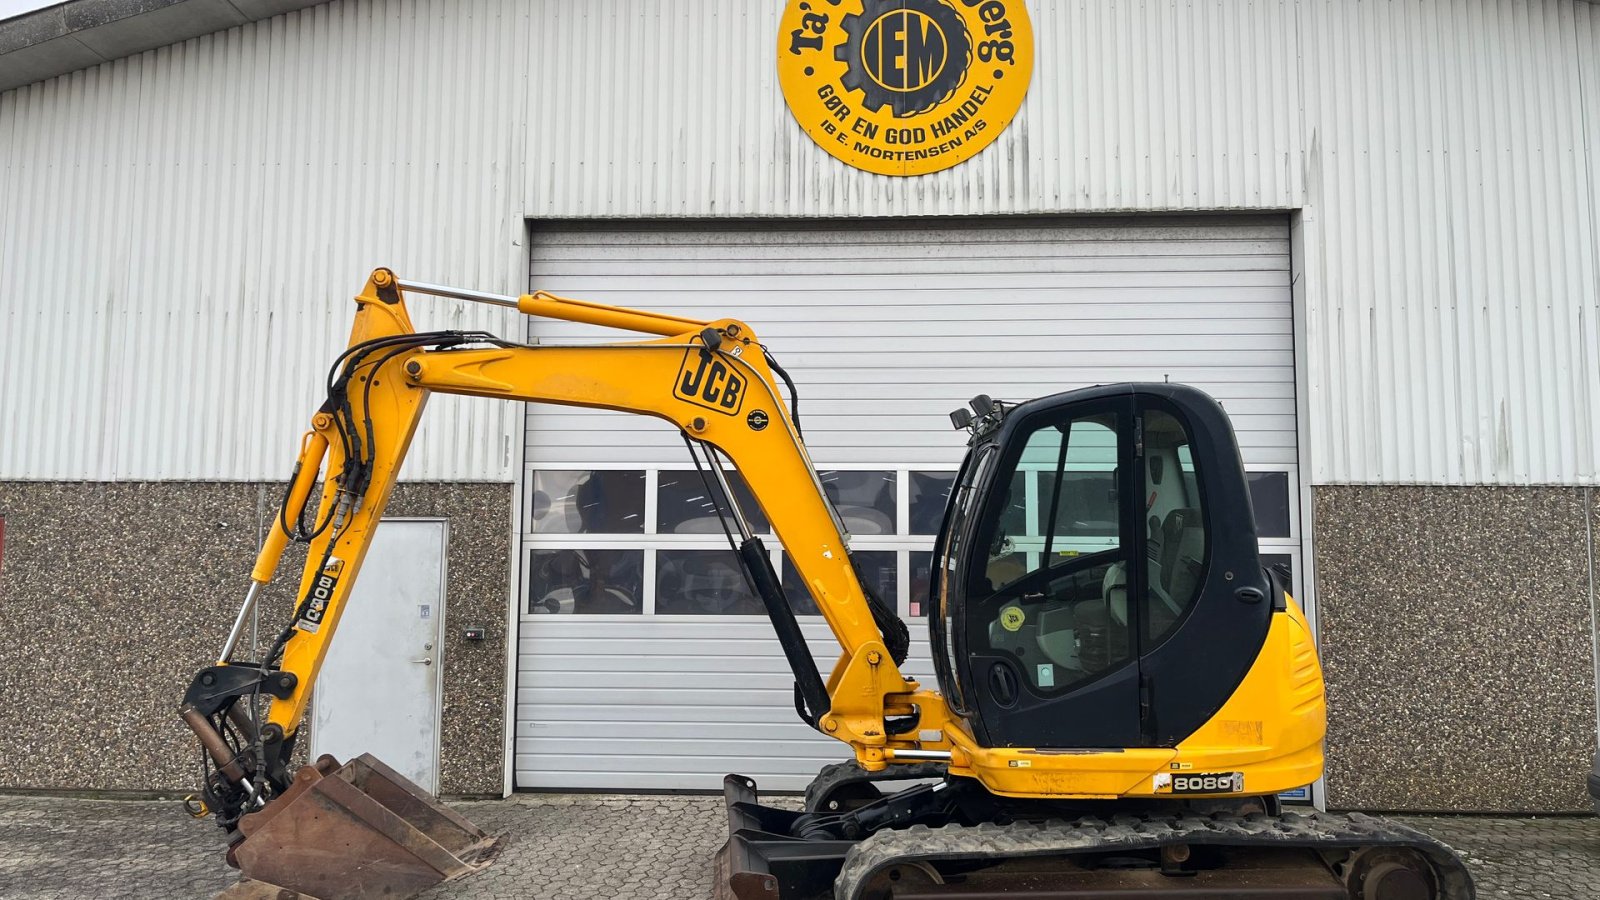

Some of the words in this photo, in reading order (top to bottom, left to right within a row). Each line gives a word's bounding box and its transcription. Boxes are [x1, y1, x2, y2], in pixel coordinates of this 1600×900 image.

[789, 1, 830, 55] Ta'
[961, 0, 1015, 66] erg
[863, 11, 945, 89] IEM
[817, 83, 852, 123] GØR
[851, 116, 880, 141] EN
[884, 127, 927, 146] GOD
[929, 84, 994, 139] HANDEL
[820, 119, 837, 136] IB
[836, 131, 849, 147] E.
[853, 136, 963, 161] MORTENSEN
[964, 118, 988, 142] A/S
[680, 348, 741, 409] JCB
[1174, 776, 1231, 790] 8080
